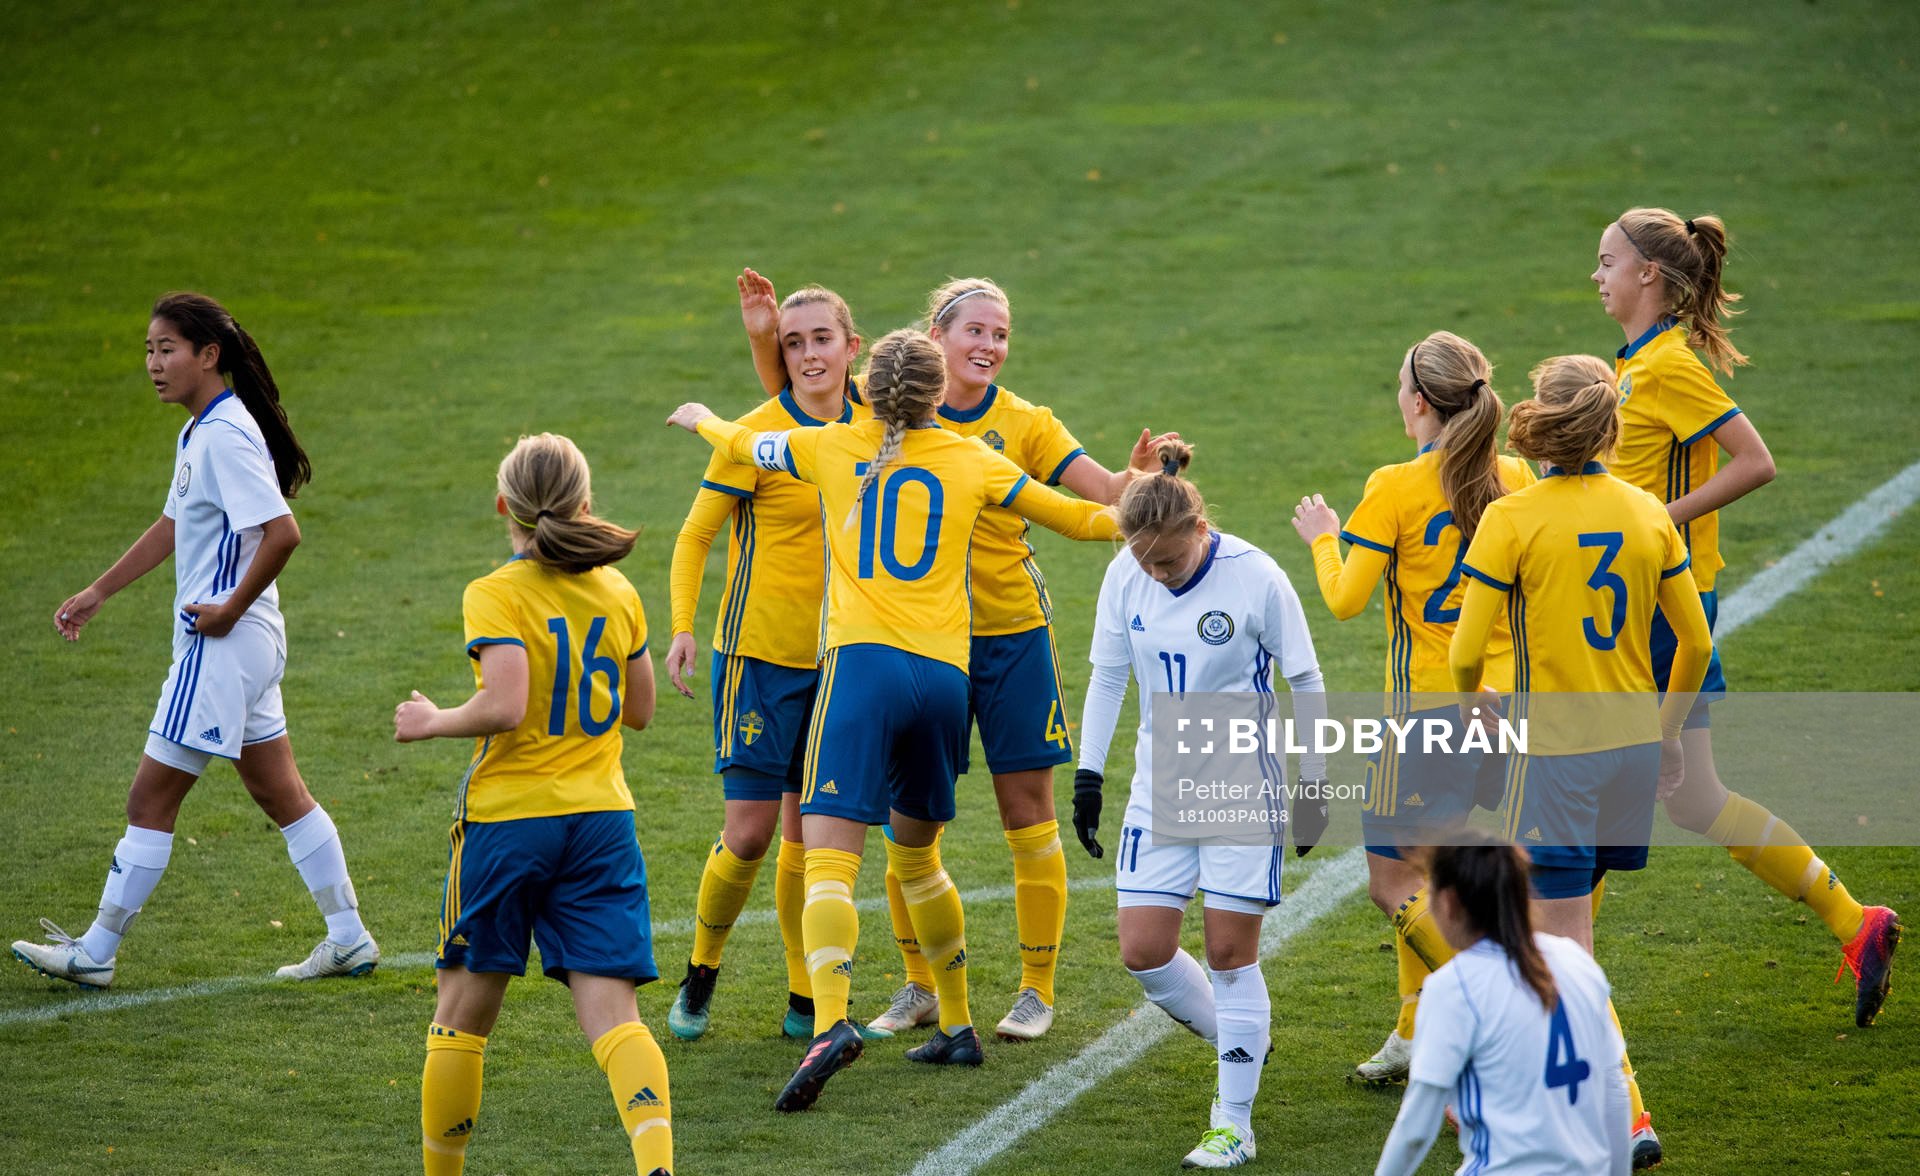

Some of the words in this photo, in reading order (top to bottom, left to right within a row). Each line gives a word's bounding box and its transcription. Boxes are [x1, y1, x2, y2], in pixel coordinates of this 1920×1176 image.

[758, 440, 775, 461] C
[855, 462, 944, 581] 10
[1423, 509, 1471, 624] 2
[1577, 531, 1628, 650] 3
[547, 616, 621, 736] 16
[1045, 700, 1066, 749] 4
[1159, 651, 1186, 701] 11
[1120, 826, 1143, 873] 11
[1545, 993, 1590, 1105] 4
